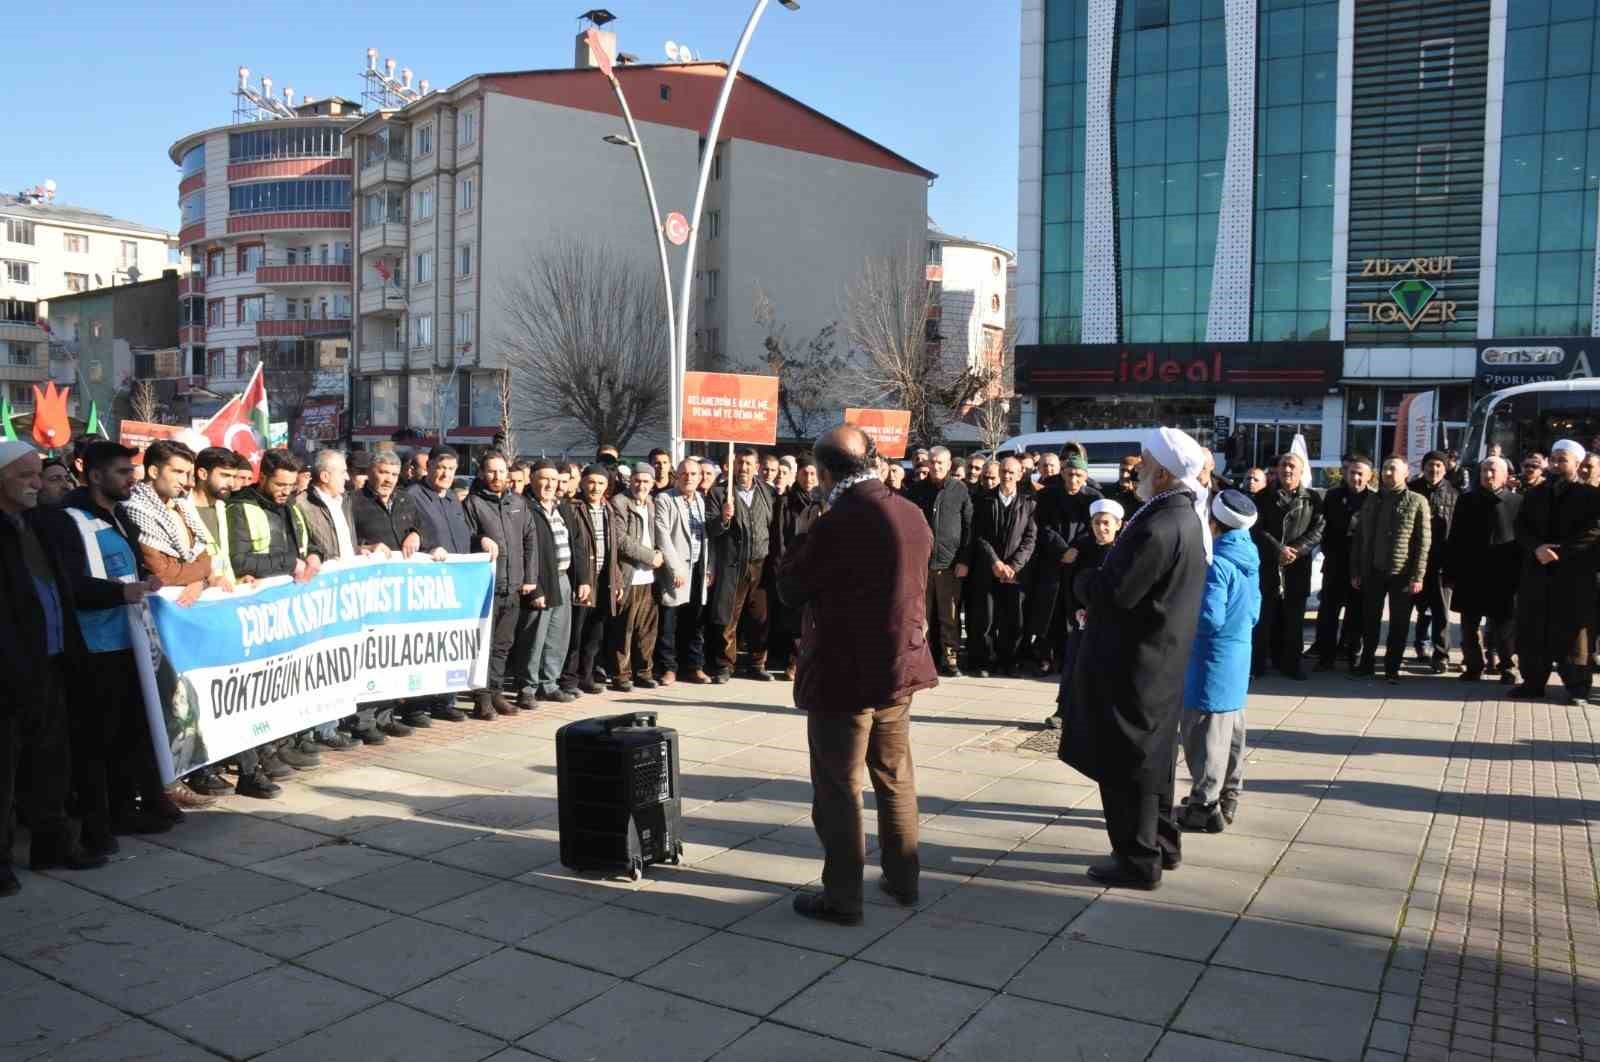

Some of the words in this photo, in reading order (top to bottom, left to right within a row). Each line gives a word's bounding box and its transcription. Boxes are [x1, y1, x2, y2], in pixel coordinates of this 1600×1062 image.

[1360, 255, 1457, 277] ZÜMRÜT
[1360, 299, 1457, 331] TOWER
[1119, 351, 1222, 384] ideal
[1485, 349, 1561, 363] emsan
[408, 567, 463, 610] İSRAİL
[210, 654, 303, 720] DÖKTÜĞÜN
